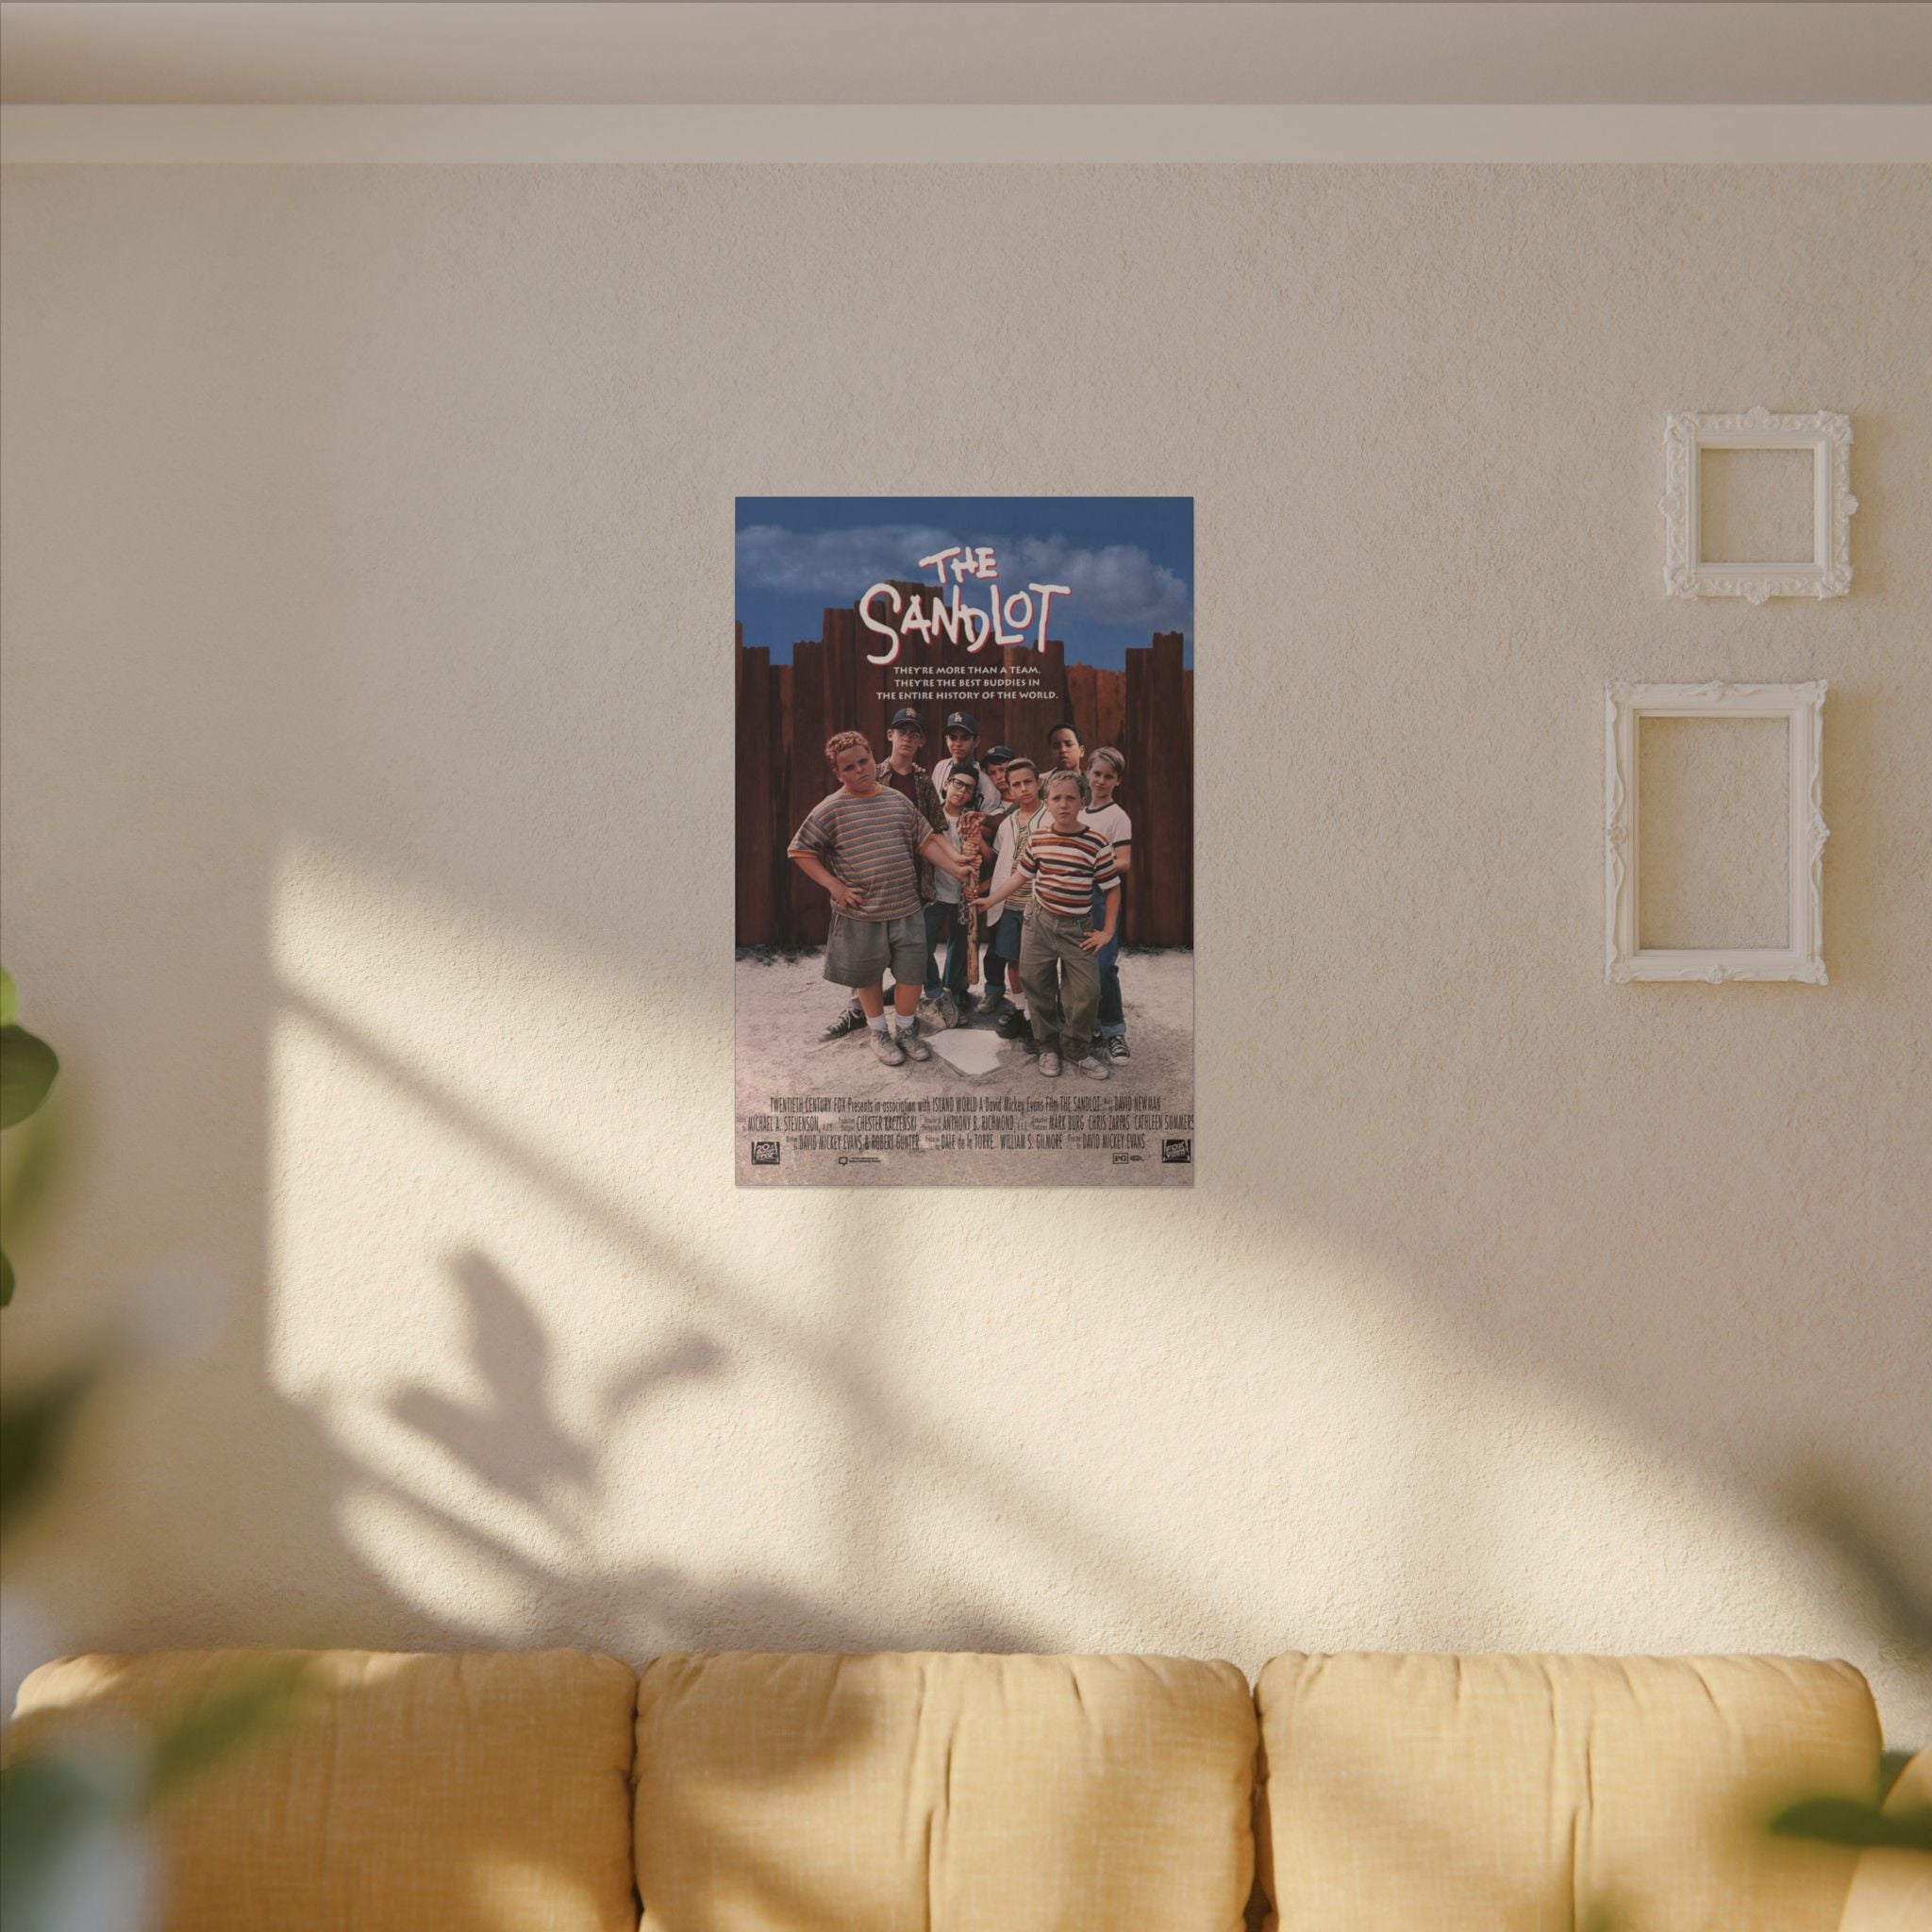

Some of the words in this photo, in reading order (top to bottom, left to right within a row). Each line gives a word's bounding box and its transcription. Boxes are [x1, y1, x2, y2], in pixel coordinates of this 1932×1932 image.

[919, 546, 998, 584] THE
[859, 583, 1072, 665] SANDLOT
[893, 666, 935, 675] THEY'RE
[936, 666, 966, 675] MORE
[968, 666, 997, 675] THAN
[999, 666, 1008, 675] A
[1010, 666, 1041, 675] TEAM.
[894, 678, 935, 687] THEY'RE
[936, 678, 957, 687] THE
[958, 678, 981, 687] BEST
[984, 678, 1025, 687] BUDDIES
[1028, 678, 1041, 687] IN
[876, 691, 896, 700] THE
[899, 691, 933, 700] ENTIRE
[936, 691, 979, 700] HISTORY
[982, 691, 996, 700] OF
[997, 691, 1018, 700] THE
[1019, 691, 1059, 700] WORLD.
[770, 1096, 803, 1112] TWENTIETH
[805, 1096, 832, 1112] CENTURY
[834, 1096, 846, 1112] FOX
[848, 1096, 874, 1112] Presents
[882, 1100, 916, 1112] association
[918, 1096, 931, 1112] with
[932, 1096, 954, 1112] ISLAND
[956, 1096, 977, 1112] WORLD
[979, 1096, 984, 1112] A
[986, 1096, 1002, 1112] David
[1004, 1096, 1024, 1116] Mickey
[1026, 1096, 1043, 1112] Evans
[1045, 1096, 1058, 1112] Film
[1060, 1096, 1071, 1112] THE
[1074, 1096, 1100, 1112] SANDLOT
[1114, 1096, 1132, 1112] DAVID
[1134, 1096, 1161, 1112] NEWMAN
[747, 1116, 774, 1131] MICHAEL
[857, 1115, 882, 1131] CHESTER
[942, 1115, 971, 1131] ANTHONY
[1049, 1114, 1066, 1130] MARK
[1068, 1114, 1084, 1130] BURG
[1088, 1114, 1107, 1130] CHRIS
[1108, 1114, 1130, 1130] ZARPAS
[1134, 1114, 1163, 1130] CATHLEEN
[1164, 1114, 1194, 1130] SUMMERS
[799, 1135, 816, 1150] DAVID
[818, 1135, 841, 1150] MICKEY
[842, 1135, 862, 1150] EVANS
[872, 1134, 894, 1150] ROBERT
[1000, 1134, 1025, 1149] WILLIAM
[1036, 1134, 1063, 1149] GILMORE
[1082, 1133, 1100, 1149] DAVID
[1102, 1133, 1124, 1149] MICKEY
[1126, 1133, 1145, 1149] EVANS
